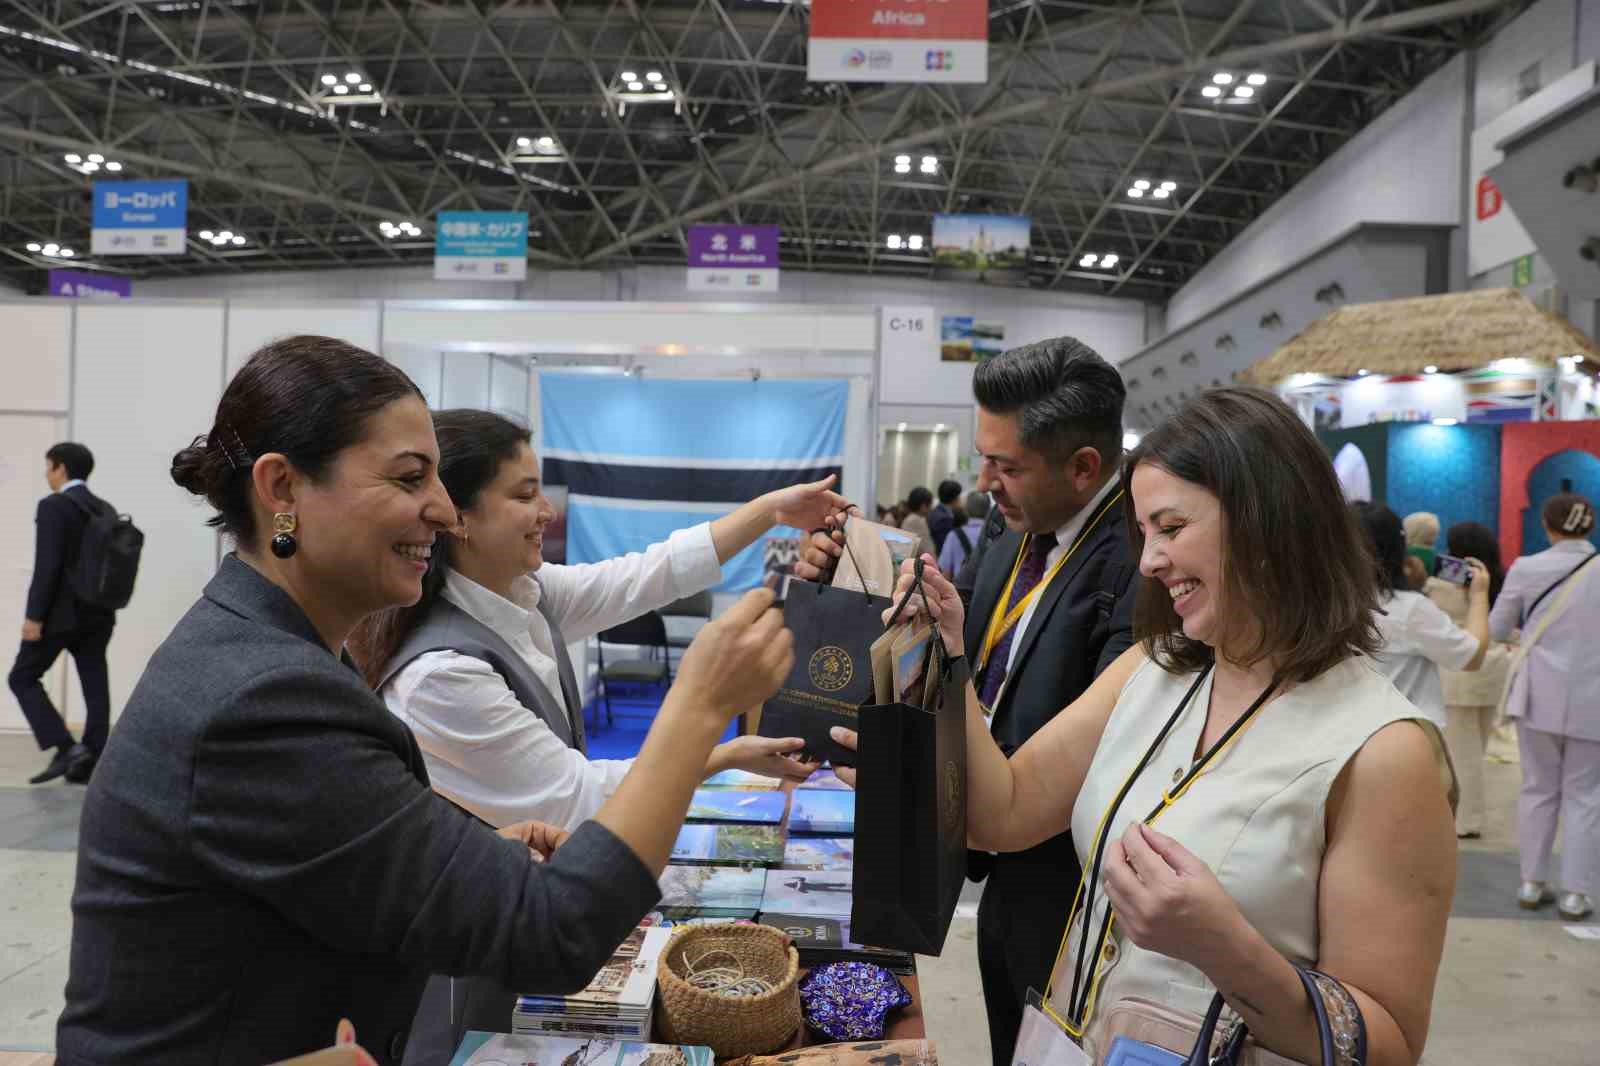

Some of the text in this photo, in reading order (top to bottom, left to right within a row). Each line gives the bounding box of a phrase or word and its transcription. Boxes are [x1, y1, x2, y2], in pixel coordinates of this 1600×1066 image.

[871, 10, 926, 26] Africa
[103, 190, 177, 209] ヨーロッパ
[889, 317, 924, 331] C-16
